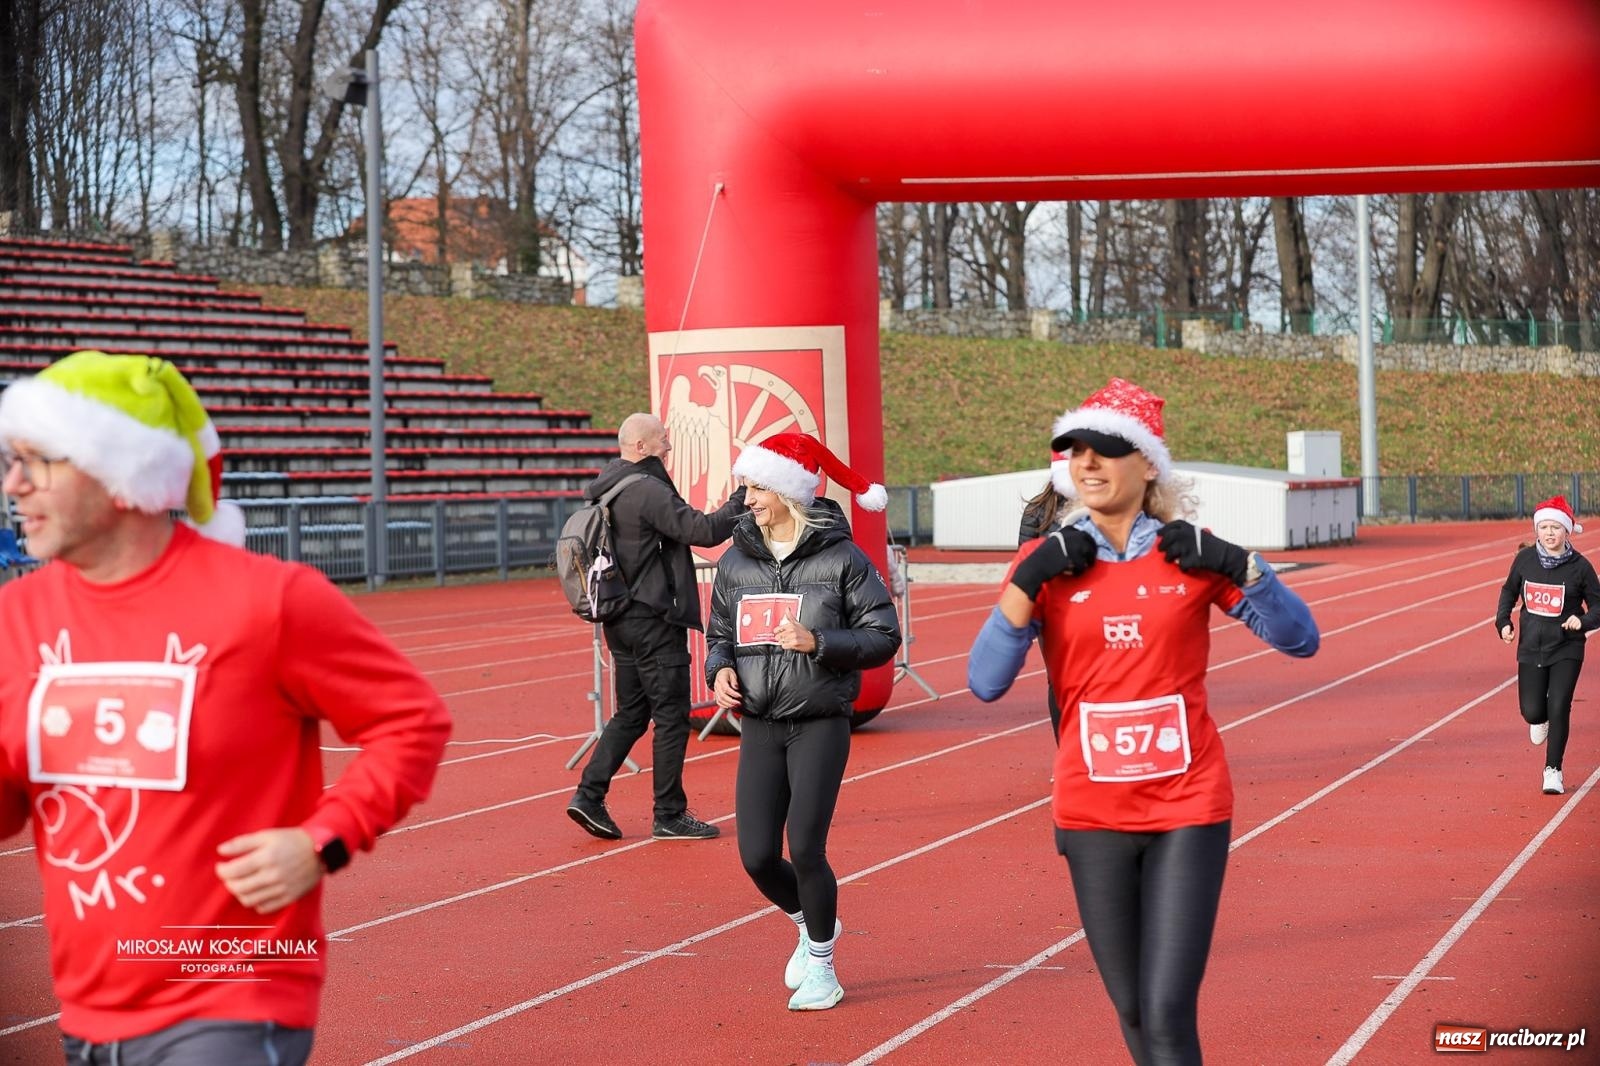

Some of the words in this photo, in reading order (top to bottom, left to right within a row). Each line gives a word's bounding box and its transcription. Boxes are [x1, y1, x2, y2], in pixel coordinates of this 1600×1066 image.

[1534, 591, 1551, 605] 20
[762, 608, 772, 627] 1
[94, 697, 126, 745] 5
[1115, 724, 1154, 756] 57
[67, 865, 165, 921] Mr.
